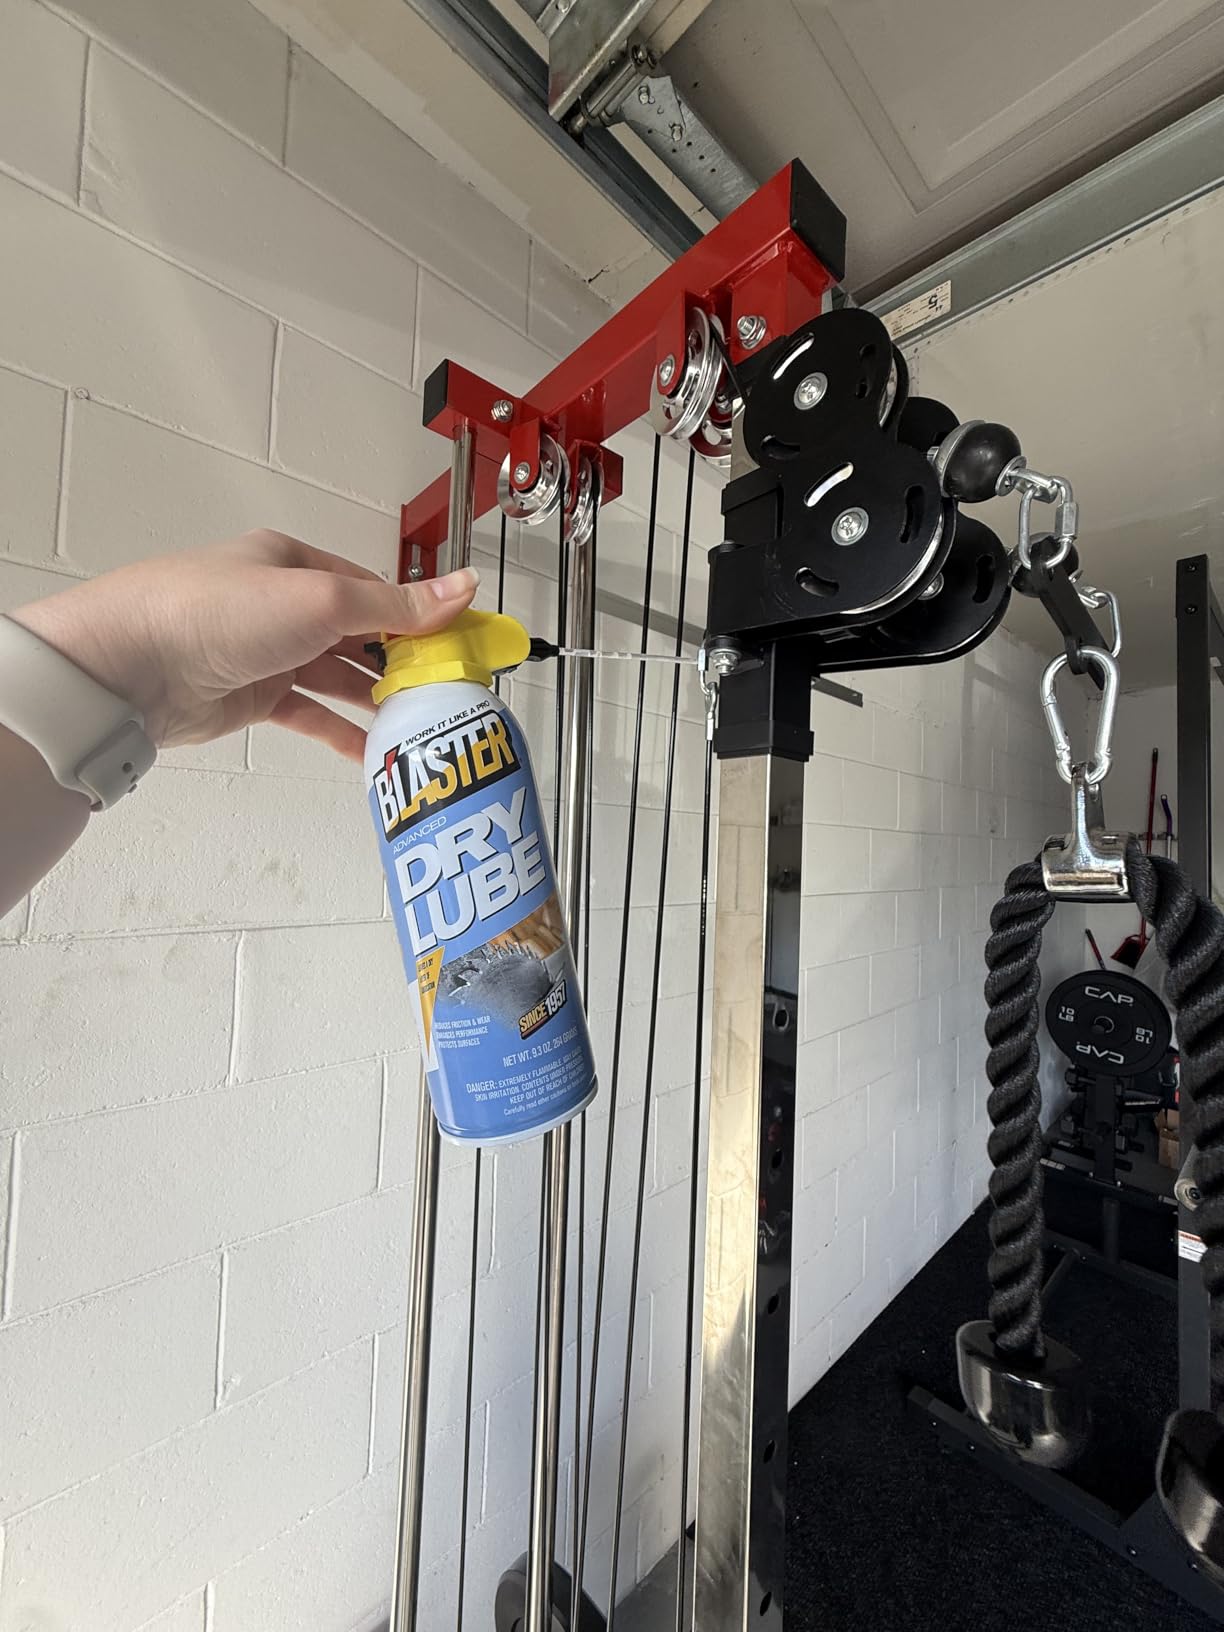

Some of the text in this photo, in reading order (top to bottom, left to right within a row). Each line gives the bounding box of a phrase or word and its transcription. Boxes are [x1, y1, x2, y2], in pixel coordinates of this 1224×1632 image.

[406, 725, 436, 746] WORK
[438, 720, 447, 730] IT
[449, 710, 469, 724] LIKE
[476, 700, 490, 711] PRO
[393, 816, 447, 854] ADVANCED
[394, 786, 526, 904] DRY
[404, 830, 546, 957] LUBE
[1084, 986, 1134, 1004] CAP
[520, 981, 566, 1032] SINCE 1957
[1058, 1012, 1074, 1022] LB
[1061, 1006, 1075, 1015] 10
[452, 1018, 472, 1028] FRICTION
[478, 1016, 490, 1025] WEAR
[455, 1026, 488, 1038] PERFORMANCE
[1136, 1026, 1153, 1038] LB
[1136, 1034, 1150, 1044] 10
[502, 1055, 516, 1068] NET
[518, 1050, 532, 1062] WT.
[532, 1046, 542, 1058] 9.3
[1076, 1044, 1124, 1064] CAP
[466, 1081, 498, 1094] DANGER:
[498, 1072, 532, 1087] EXTREMELY
[474, 1092, 488, 1102] SKIN
[522, 1074, 550, 1091] CONTENTS
[510, 1094, 525, 1105] KEEP
[526, 1088, 537, 1100] OUT
[538, 1085, 546, 1096] OF
[546, 1077, 563, 1094] REACH
[562, 1074, 570, 1085] OF
[504, 1105, 526, 1116] Carefully
